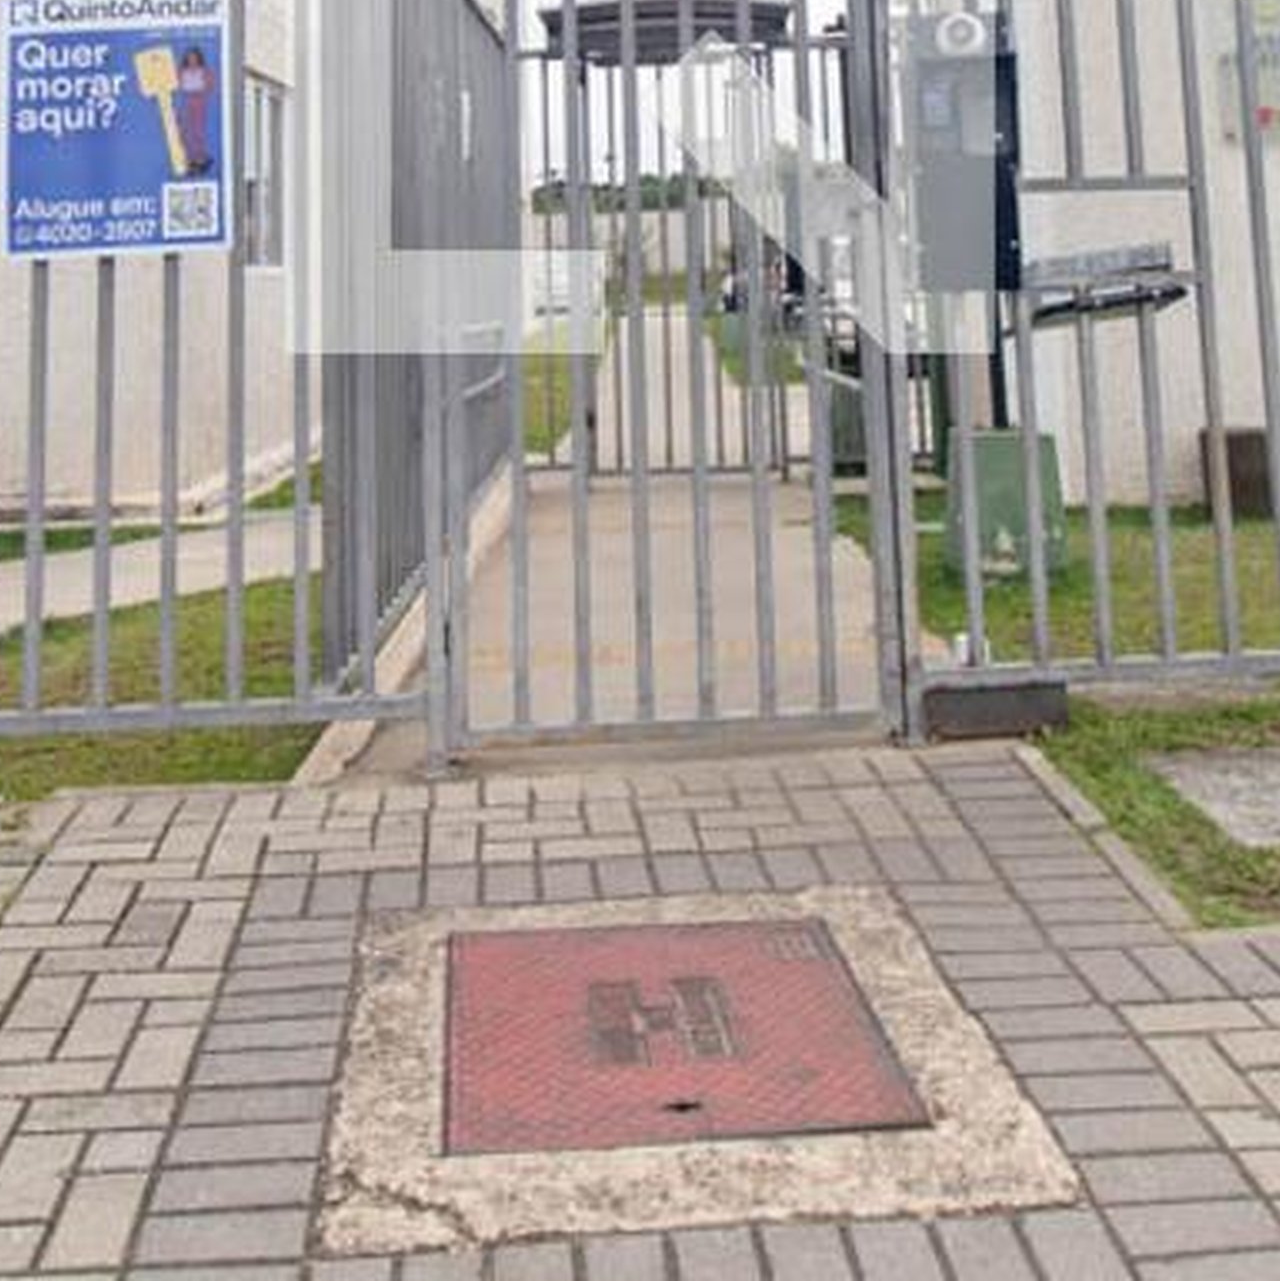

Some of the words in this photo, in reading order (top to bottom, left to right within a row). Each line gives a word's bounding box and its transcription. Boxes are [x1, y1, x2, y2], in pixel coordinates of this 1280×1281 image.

[16, 39, 109, 69] Quer
[17, 72, 126, 101] morar
[15, 98, 117, 137] aqui?
[13, 197, 105, 220] Alugue
